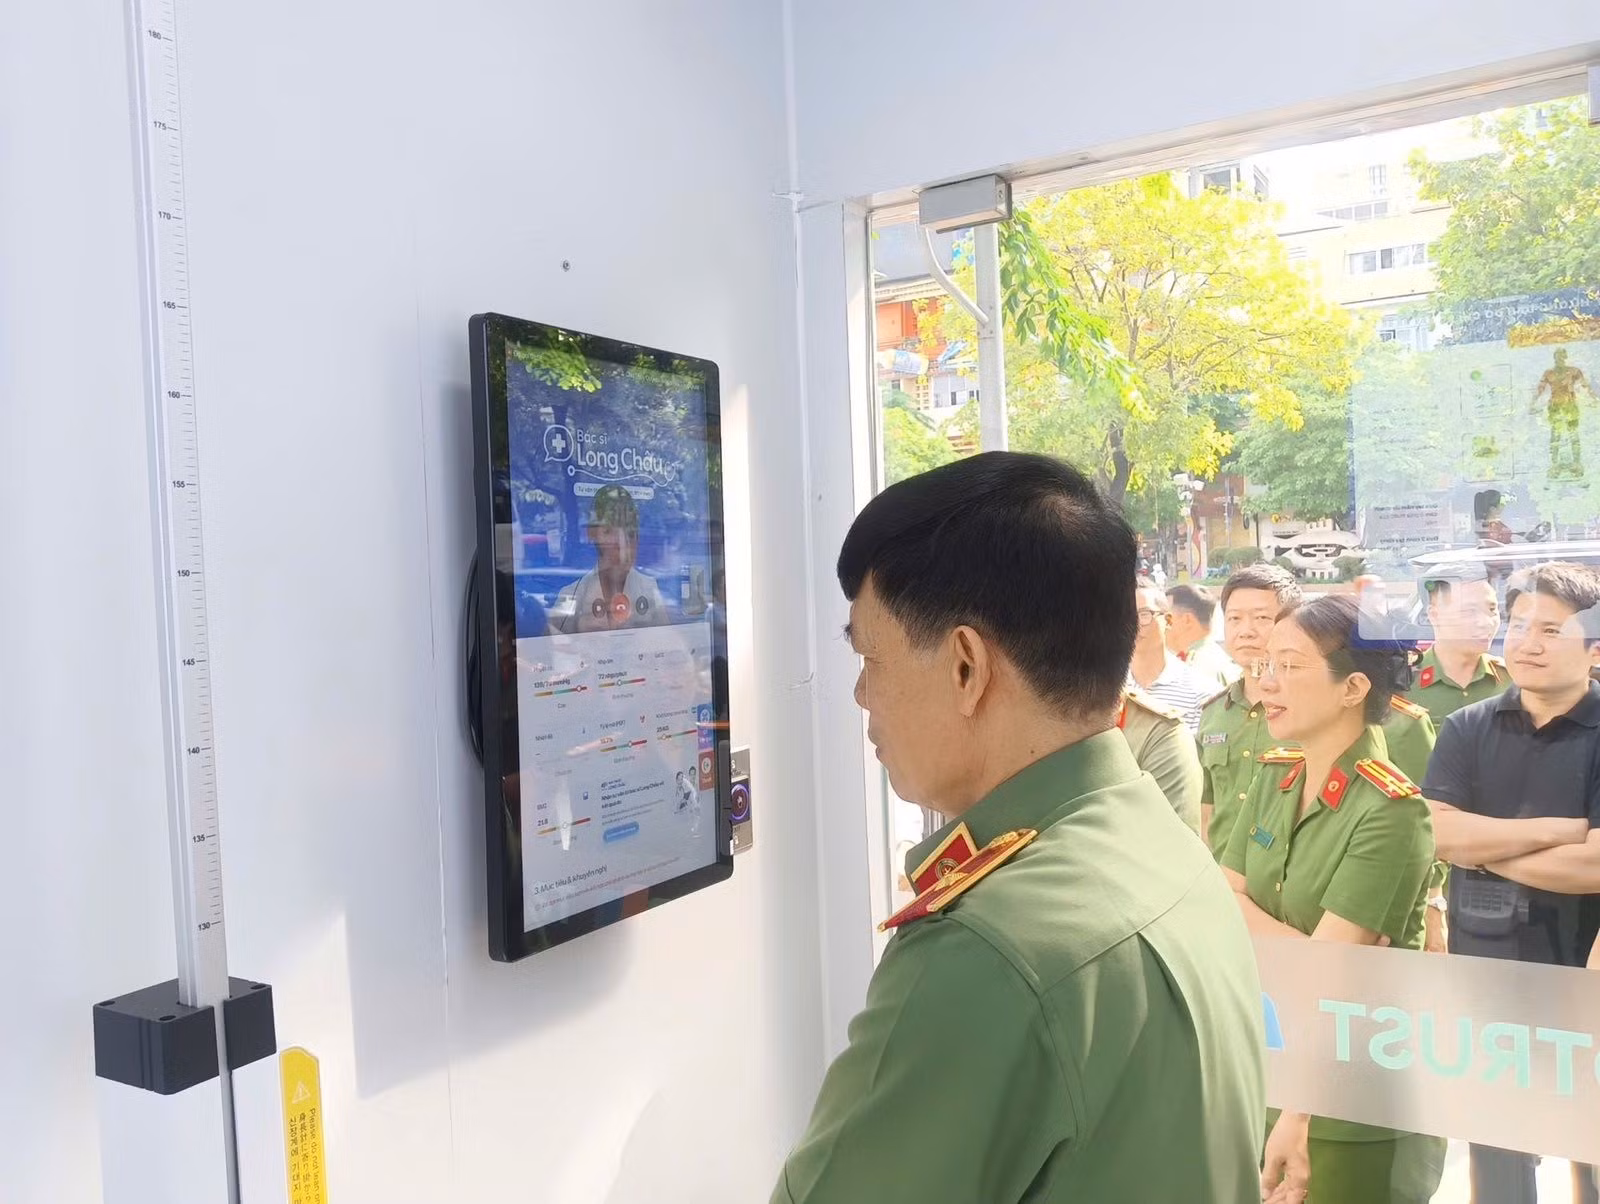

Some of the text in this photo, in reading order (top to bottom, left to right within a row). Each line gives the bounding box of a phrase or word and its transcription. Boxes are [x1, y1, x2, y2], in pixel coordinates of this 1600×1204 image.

[148, 30, 161, 40] 180
[153, 121, 167, 131] 175
[158, 211, 171, 220] 170
[163, 301, 176, 310] 165
[167, 390, 180, 399] 160
[576, 429, 596, 443] Bác
[577, 443, 663, 475] Long Châu
[172, 481, 185, 489] 155
[177, 569, 190, 578] 150
[182, 657, 195, 667] 145
[187, 746, 200, 756] 140
[192, 834, 205, 844] 135
[198, 922, 210, 932] 130
[309, 1107, 317, 1139] Please
[311, 1141, 317, 1154] do
